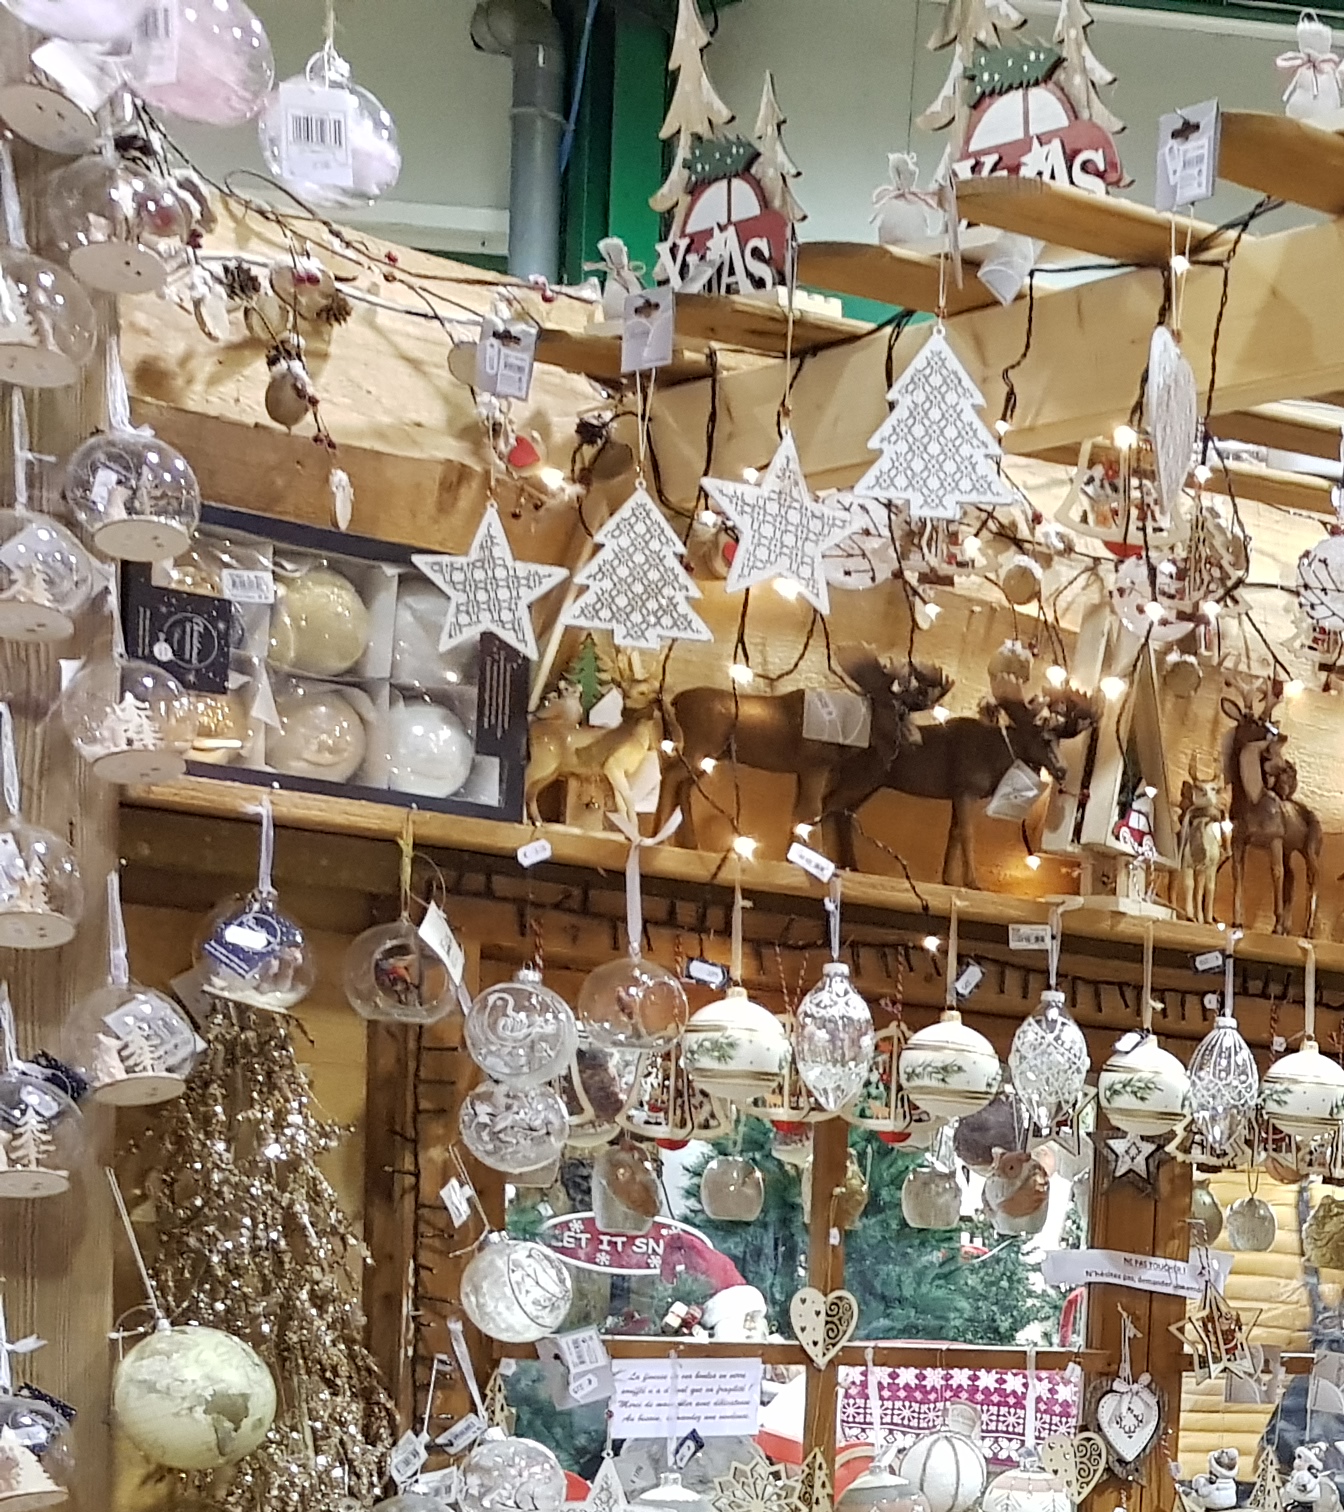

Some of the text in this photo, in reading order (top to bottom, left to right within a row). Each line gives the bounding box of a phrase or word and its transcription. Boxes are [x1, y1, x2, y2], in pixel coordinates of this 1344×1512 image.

[598, 1234, 627, 1252] IT
[631, 1237, 665, 1255] SN
[1134, 1258, 1149, 1269] PAS
[618, 1400, 642, 1408] Merci
